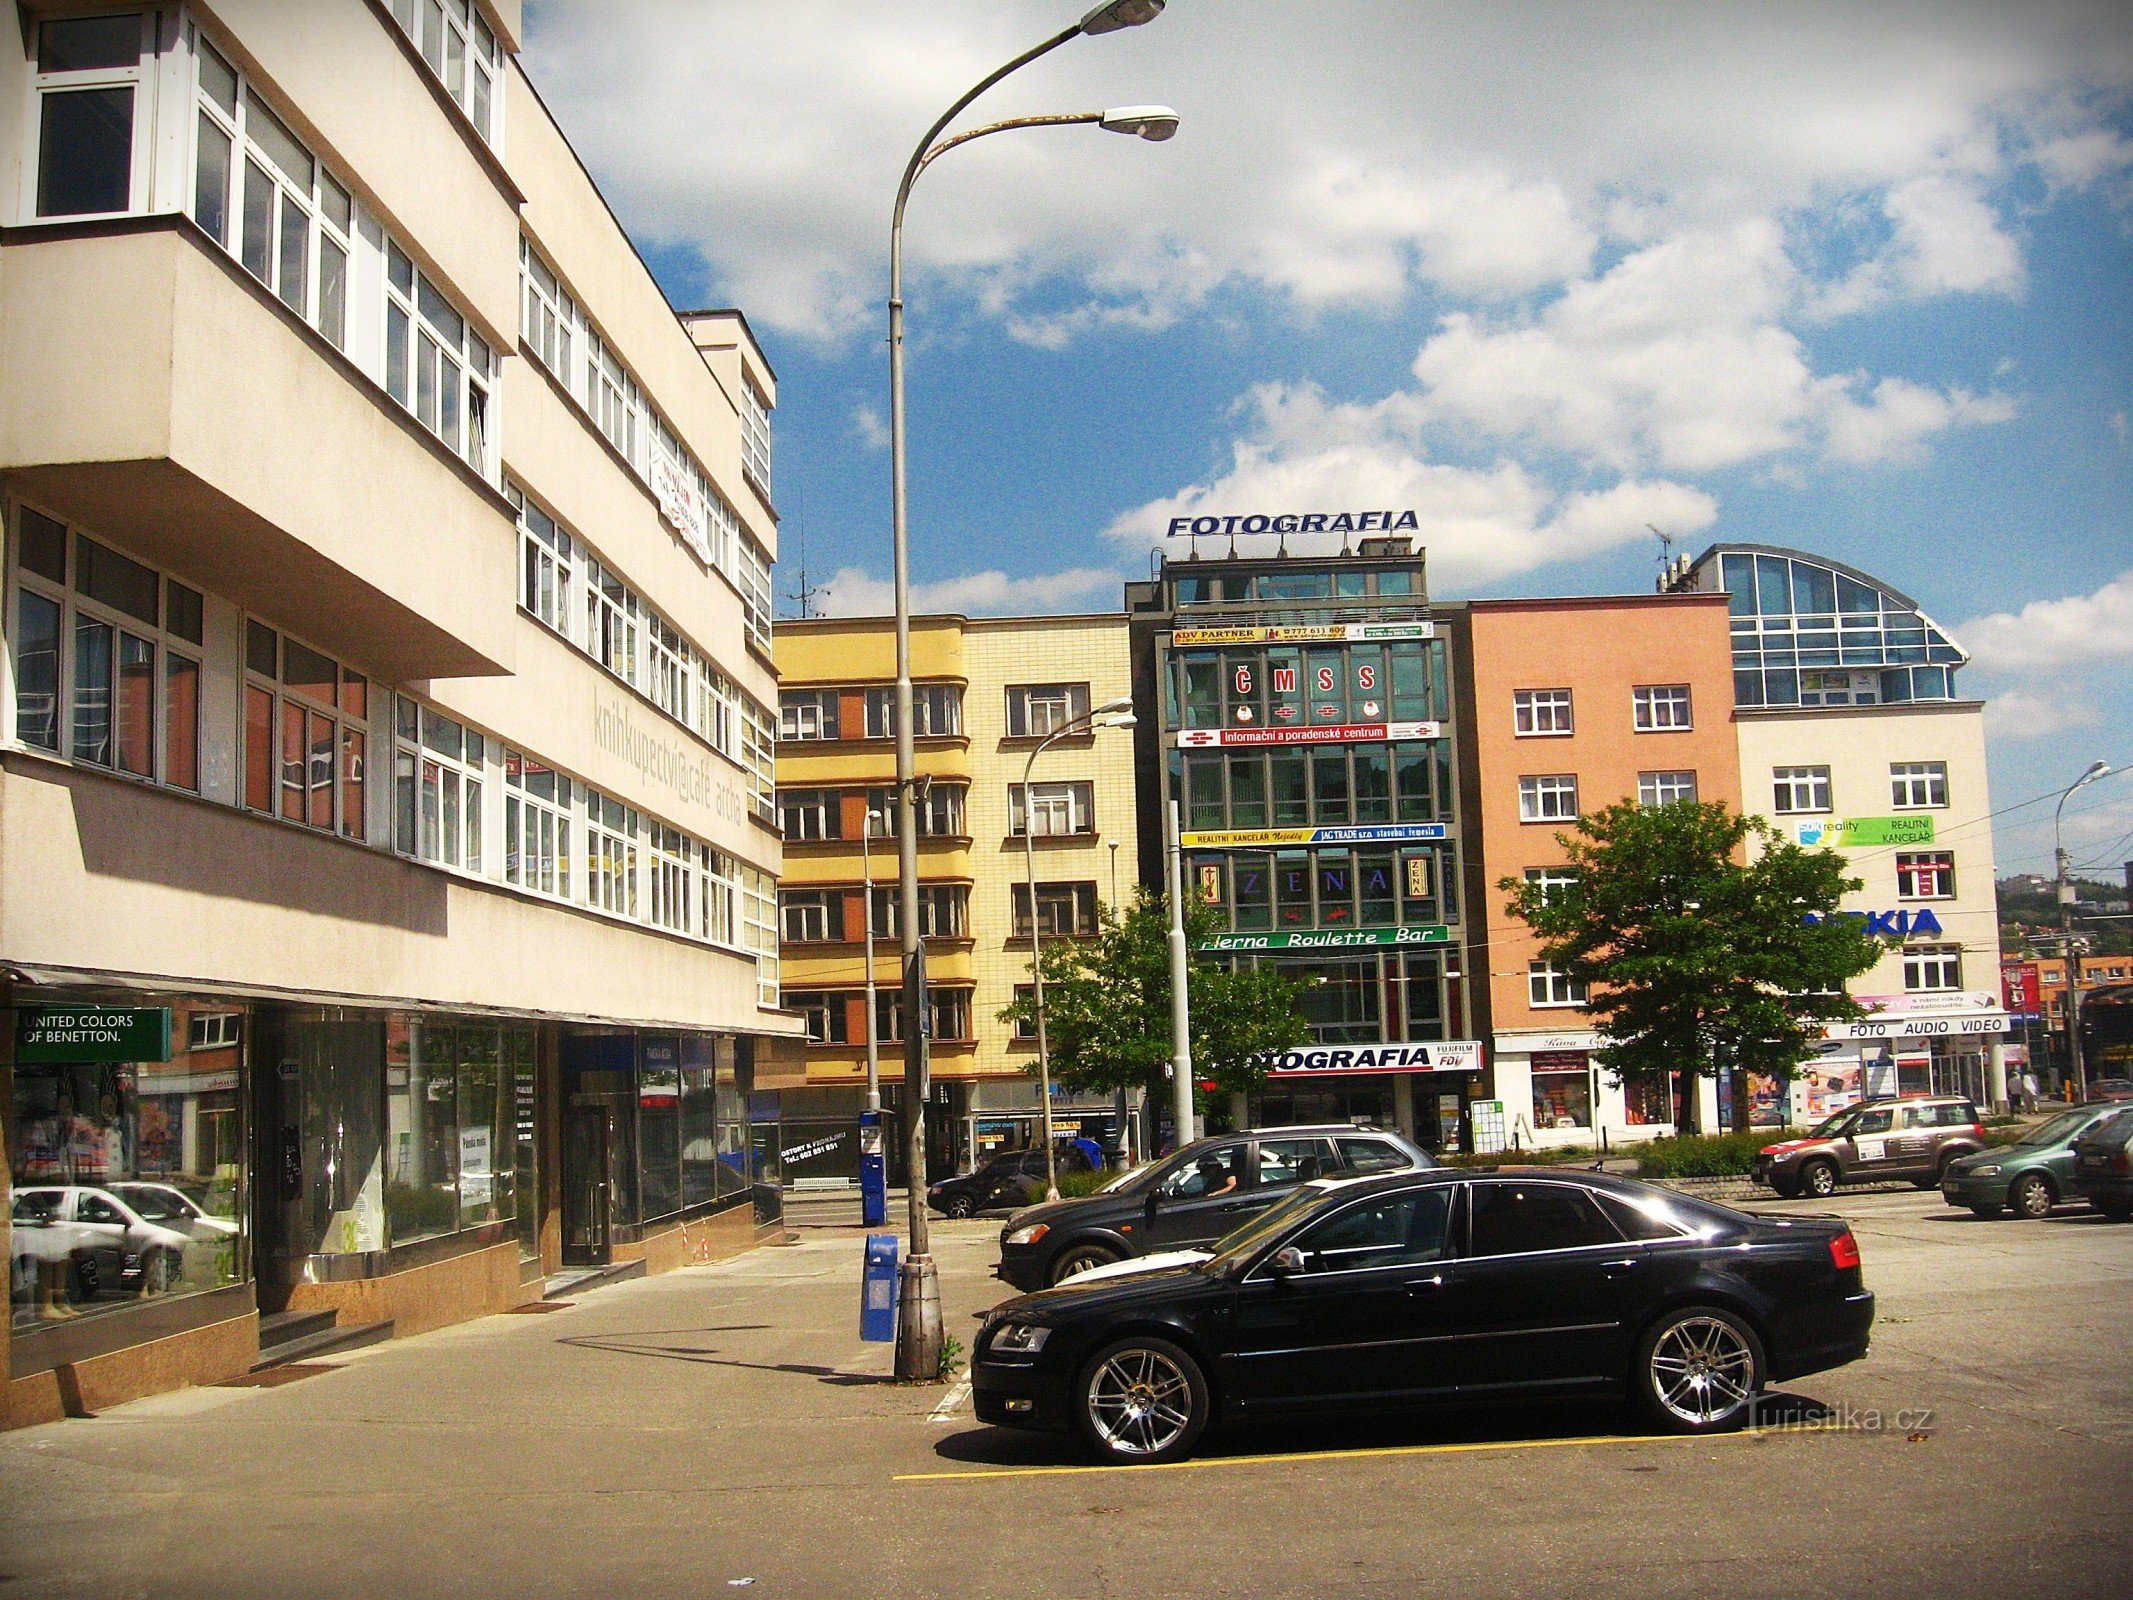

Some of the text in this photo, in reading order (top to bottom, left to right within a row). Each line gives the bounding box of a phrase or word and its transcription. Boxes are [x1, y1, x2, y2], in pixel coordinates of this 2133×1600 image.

[1167, 511, 1420, 539] FOTOGRAFIA
[1175, 630, 1254, 639] ADV PARTNER
[1225, 730, 1276, 742] Informační
[1278, 732, 1286, 741] a
[1285, 728, 1341, 742] poradenské
[1344, 727, 1383, 738] centrum
[1287, 931, 1377, 947] Roulette
[1395, 927, 1434, 942] Bar
[25, 1015, 134, 1028] UNITED COLORS
[1849, 1019, 2002, 1037] FOTO AUDIO VIDEO
[24, 1030, 121, 1043] OF BENETTON.
